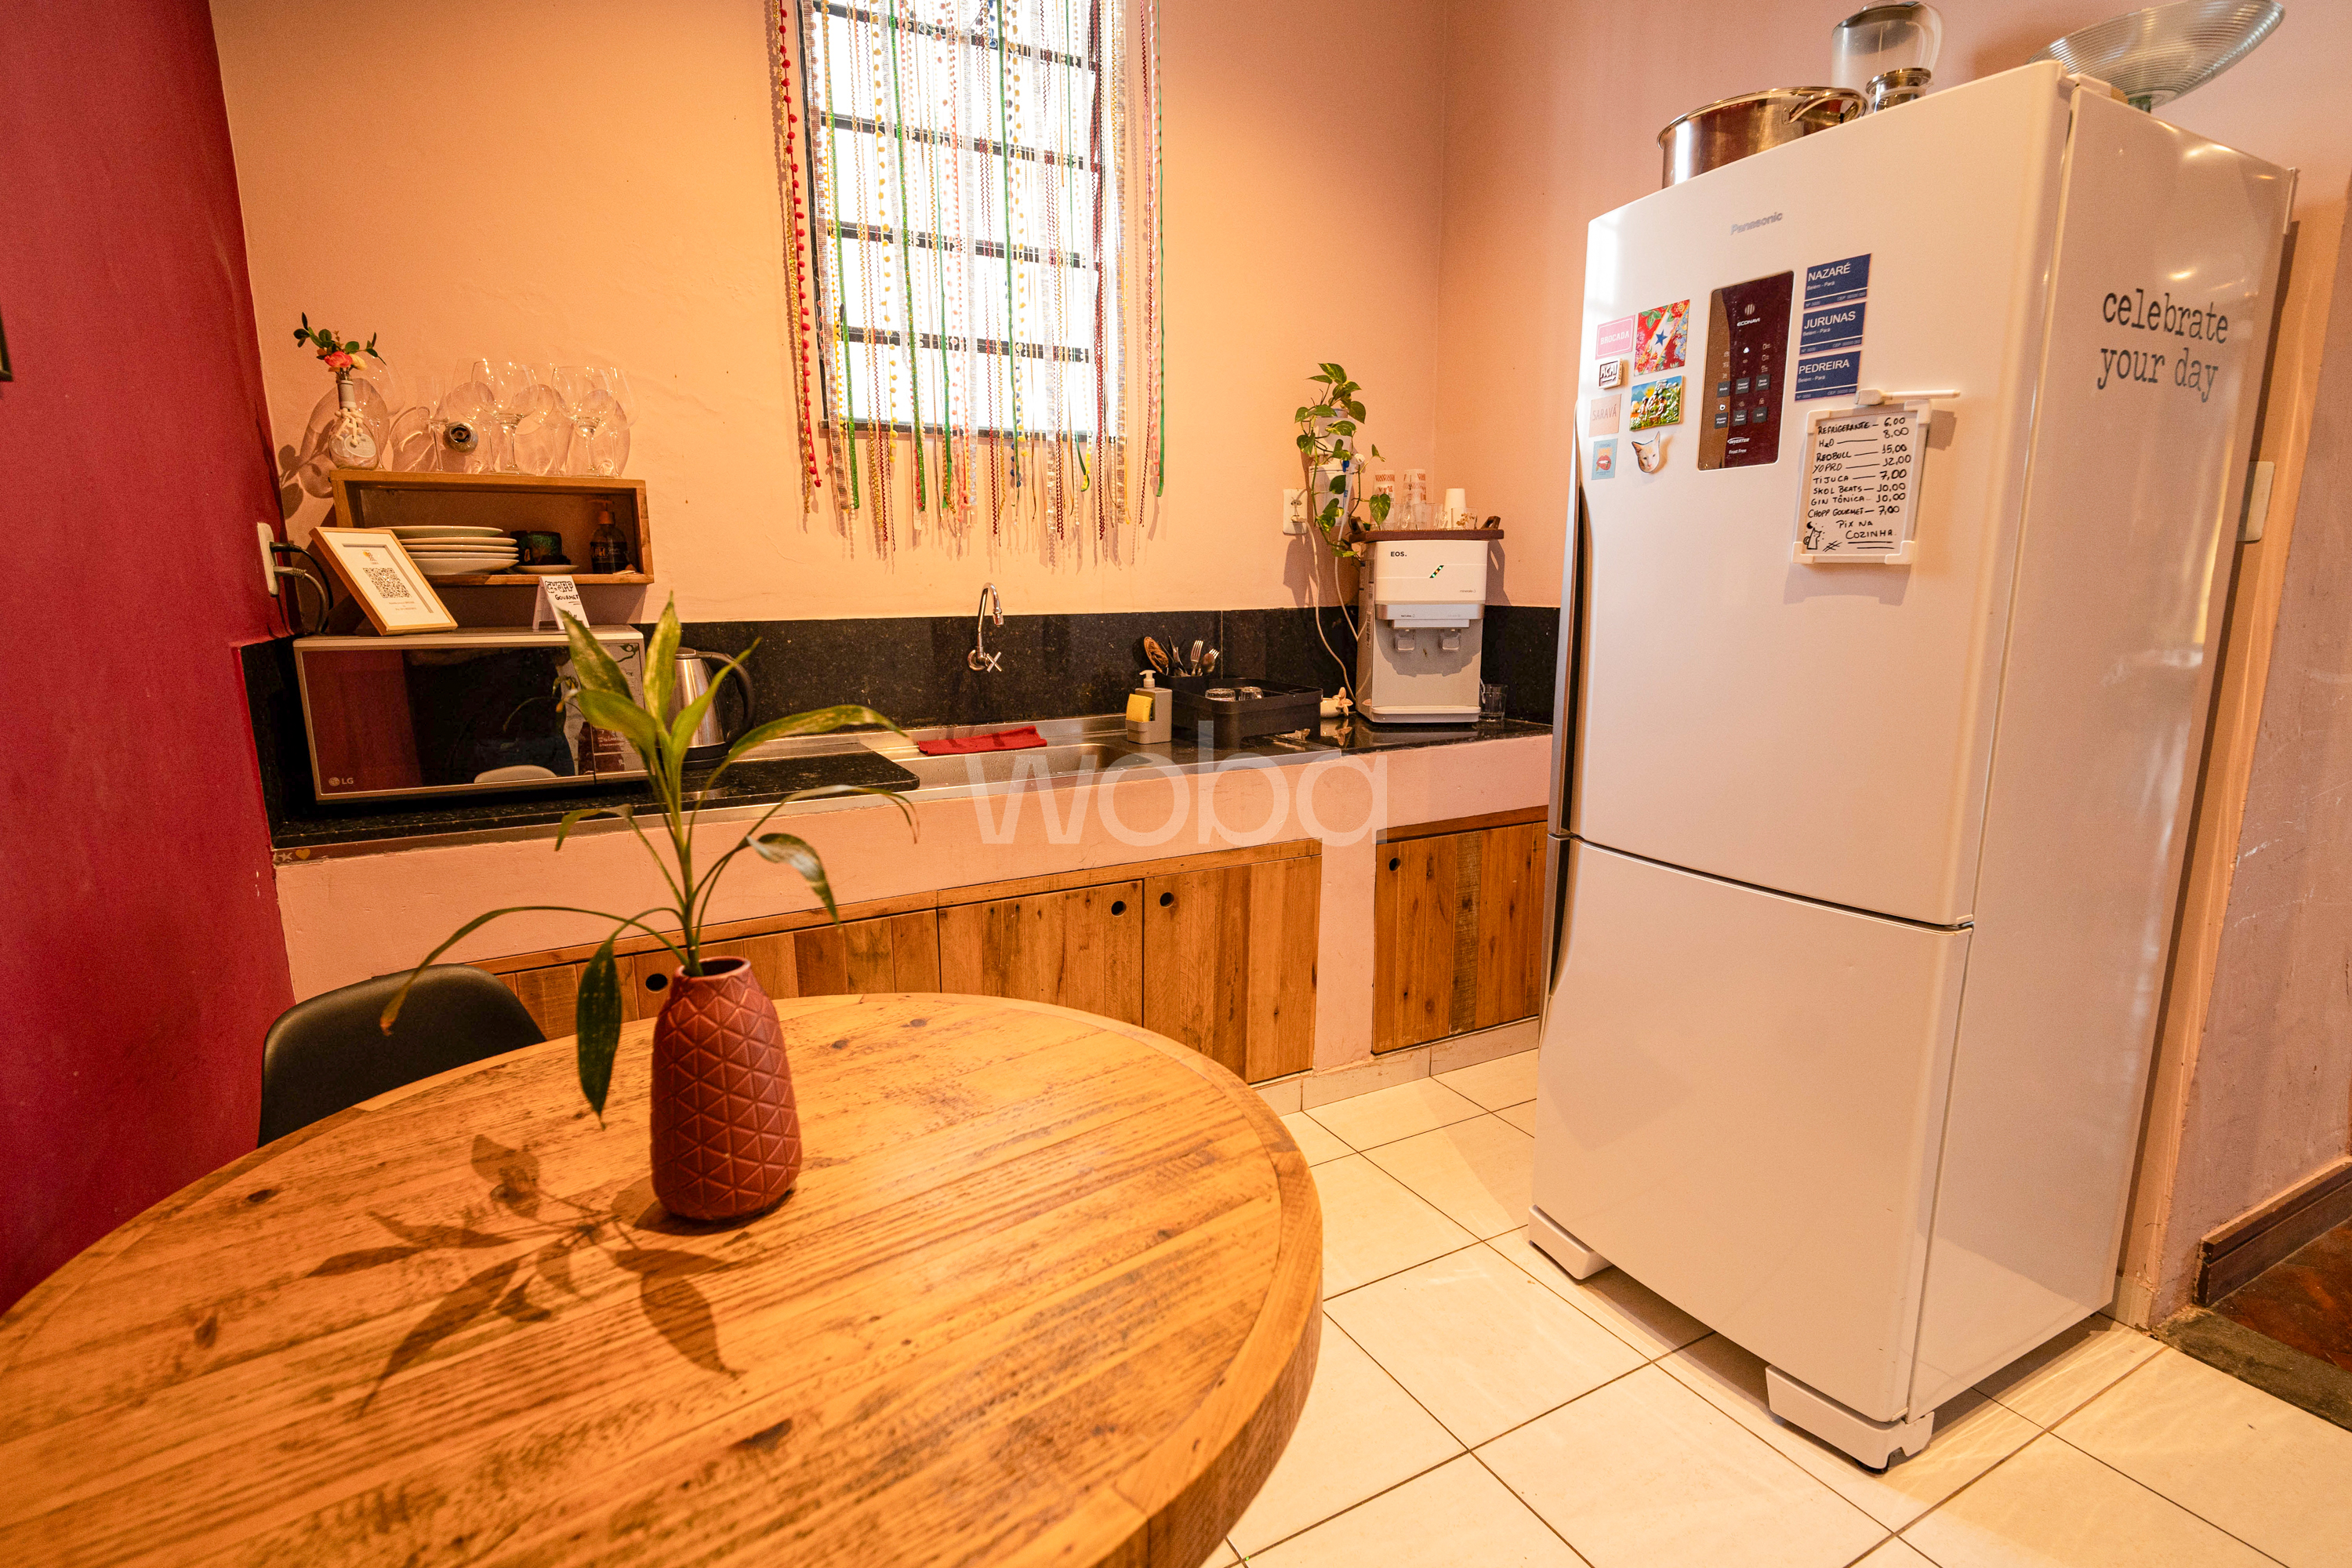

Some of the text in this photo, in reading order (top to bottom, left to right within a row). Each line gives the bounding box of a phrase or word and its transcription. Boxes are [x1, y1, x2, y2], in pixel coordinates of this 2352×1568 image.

[1730, 212, 1783, 235] Panasonic
[1808, 262, 1851, 281] NAZARÉ
[1737, 318, 1761, 327] ECONAVI
[1804, 310, 1856, 329] JURUNAS
[2103, 288, 2228, 344] celebrate
[1600, 330, 1630, 345] BROCADA
[1798, 358, 1850, 375] PEDREIRA
[2097, 347, 2219, 403] your day
[1592, 404, 1617, 421] SARAVÁ
[1879, 469, 1907, 481] 7,00
[1807, 509, 1830, 518] CHOPP
[1832, 507, 1864, 517] GOURMET
